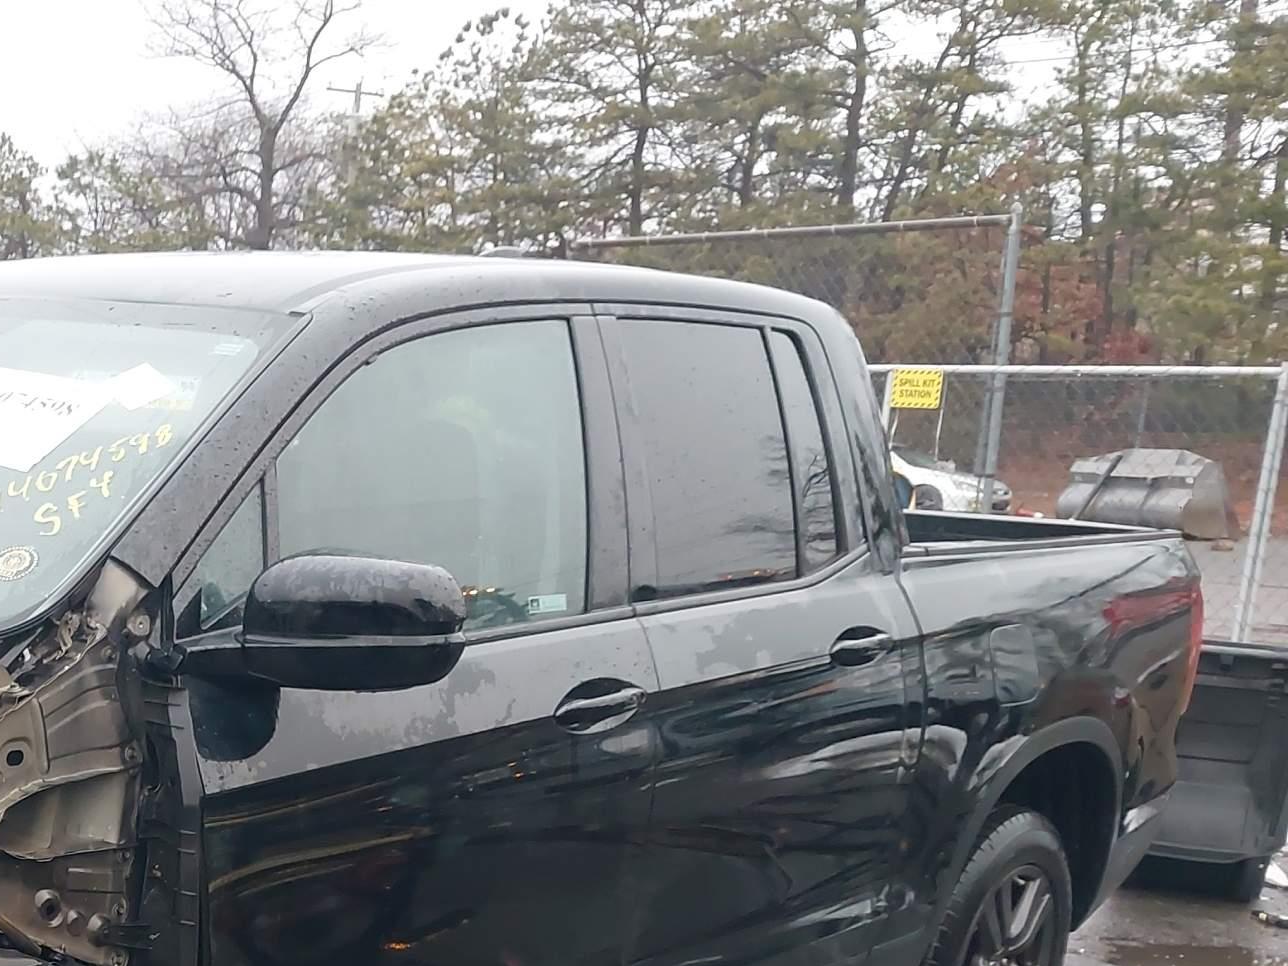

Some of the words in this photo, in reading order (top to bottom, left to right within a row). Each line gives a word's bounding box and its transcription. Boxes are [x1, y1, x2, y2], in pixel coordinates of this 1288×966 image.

[898, 378, 920, 388] SPILL
[922, 379, 936, 388] KIT
[899, 389, 932, 399] STATION
